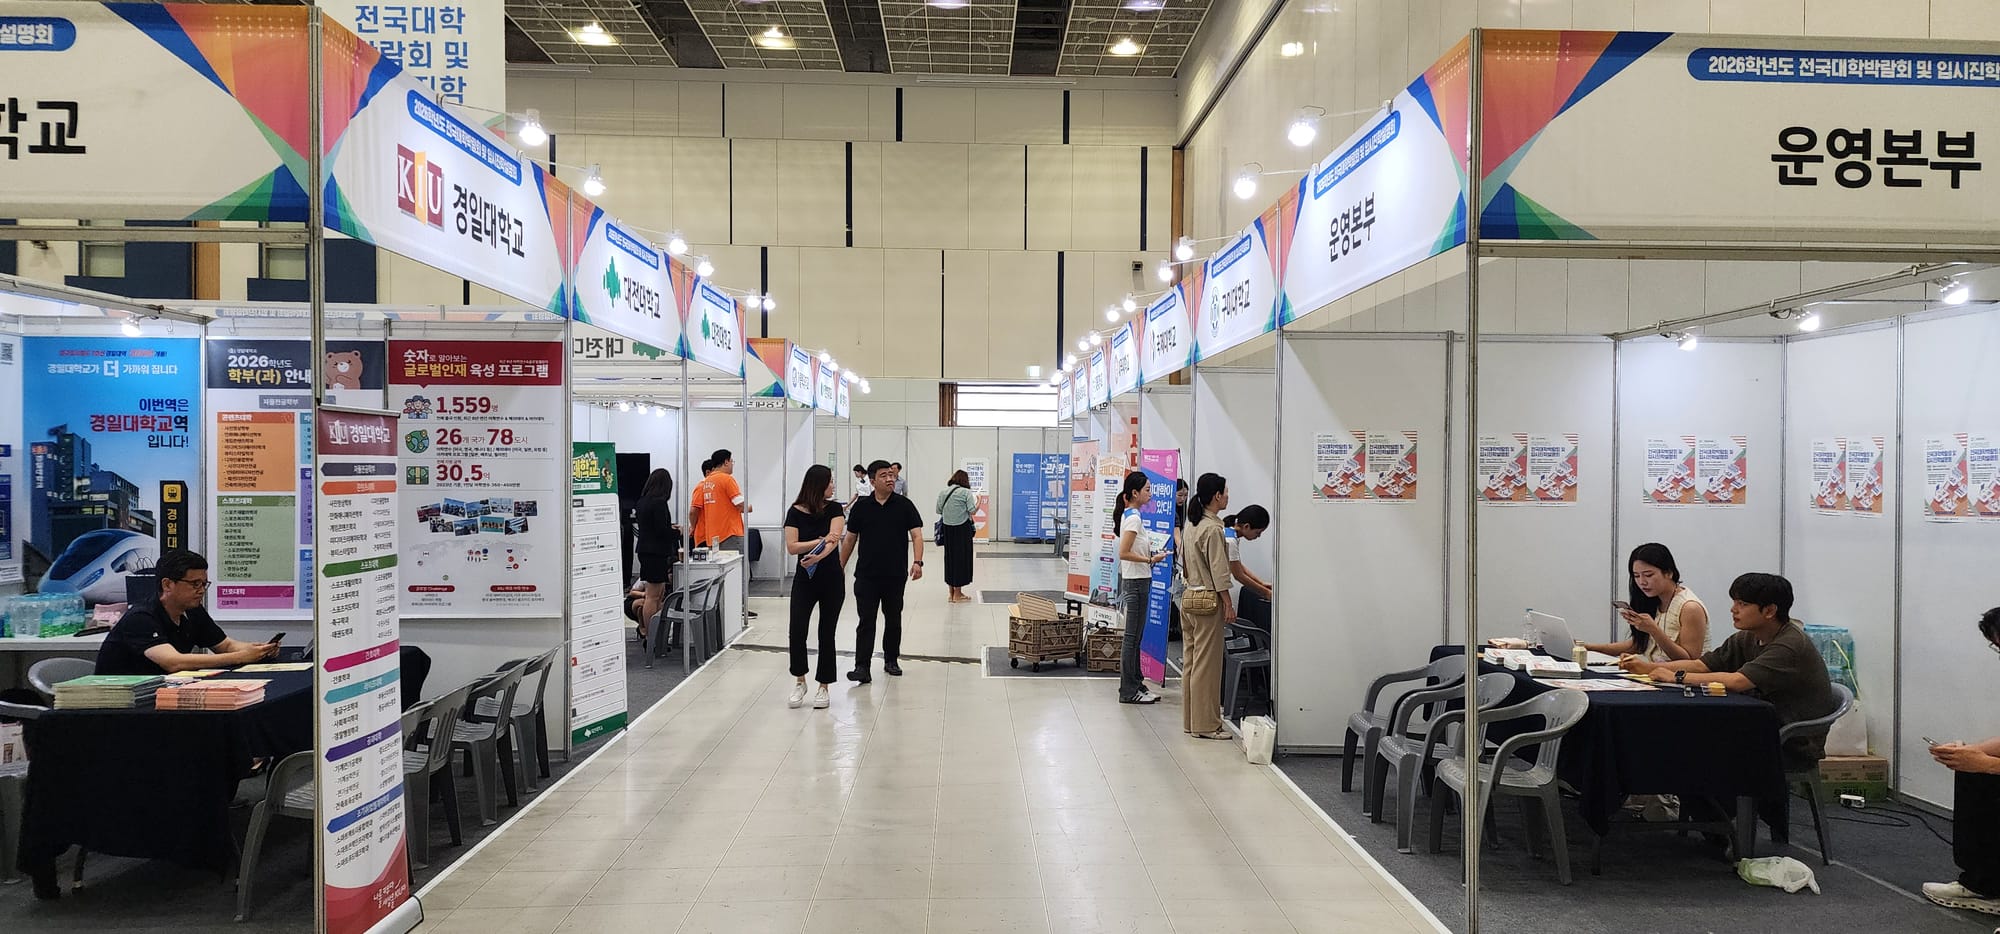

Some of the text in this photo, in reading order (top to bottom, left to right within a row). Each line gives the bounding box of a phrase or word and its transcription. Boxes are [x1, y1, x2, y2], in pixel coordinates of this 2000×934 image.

[355, 5, 466, 35] 전국대학
[0, 23, 54, 45] 설명회
[369, 40, 469, 70] 람회 및
[1708, 55, 2000, 81] 2026학년도 전국대학박람회 및 입시진학
[1771, 126, 1982, 189] 운영본부
[398, 155, 442, 215] KIU
[453, 183, 525, 258] 경일대학교
[1329, 191, 1376, 262] 운영본부
[623, 277, 661, 319] 대전대학교
[1221, 278, 1251, 324] 구미대학교
[711, 321, 732, 350] 대전대학교
[227, 355, 293, 368] 2026학년도
[403, 349, 468, 363] 숫자로 알아보는
[47, 360, 178, 378] 경일대학교가 더 가까워 집니다
[227, 368, 311, 385] 학부(과) 안내
[403, 363, 549, 378] 글로벌인재 육성 프로그램
[139, 398, 189, 412] 이번역은
[89, 414, 189, 433] 경일대학교역
[349, 424, 391, 443] 경일대학교
[147, 434, 189, 449] 입니다!
[470, 436, 485, 445] 국가
